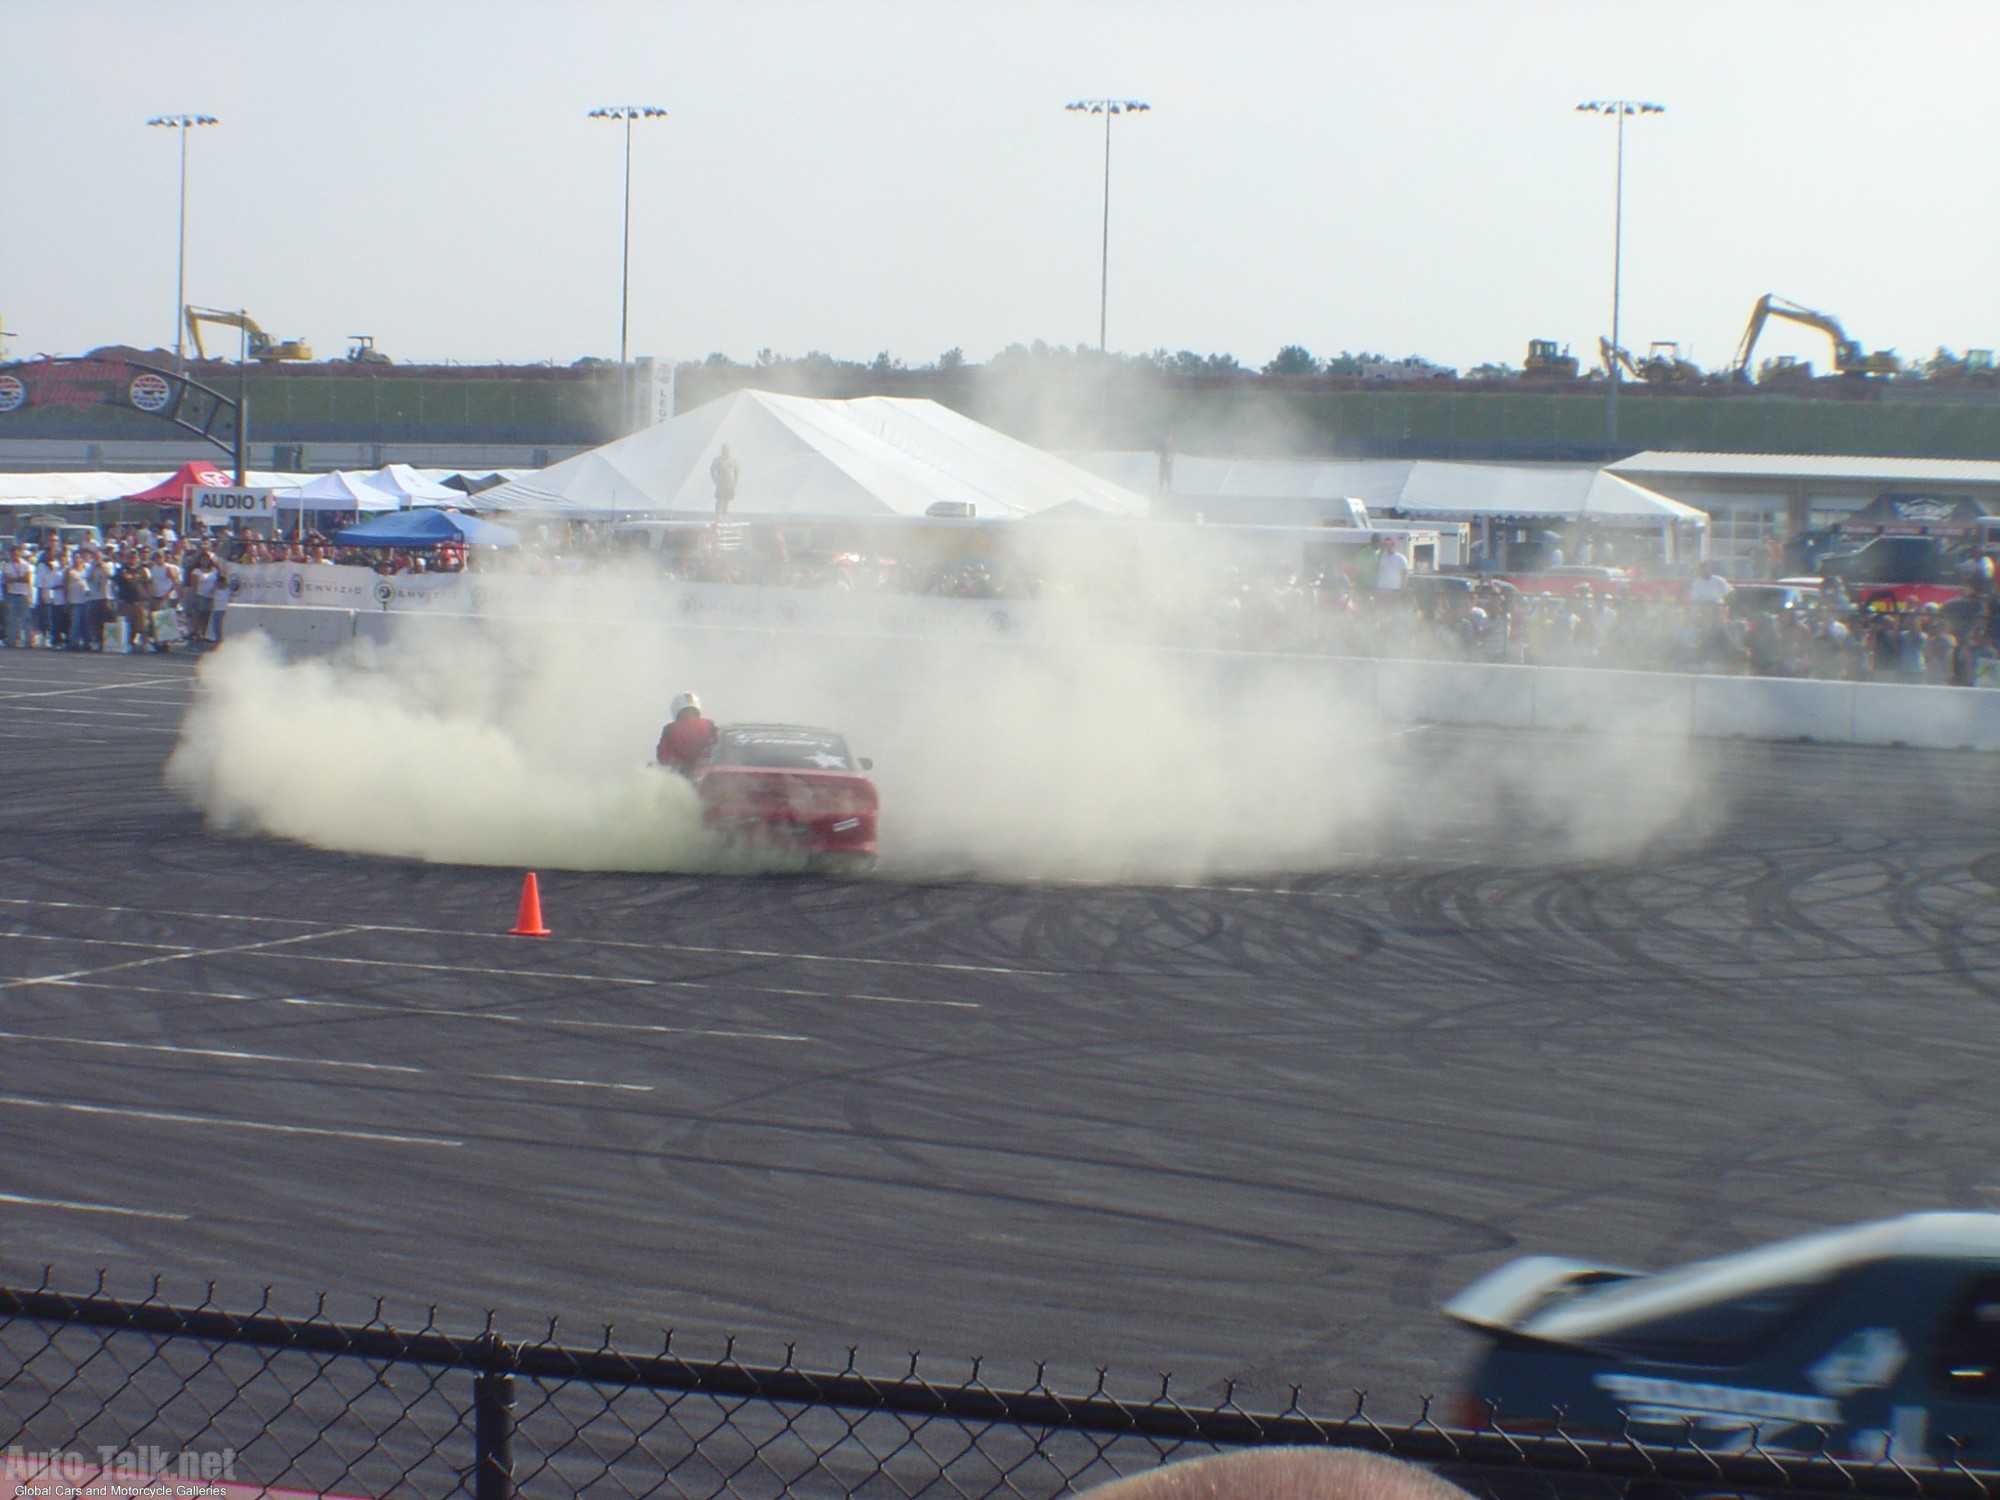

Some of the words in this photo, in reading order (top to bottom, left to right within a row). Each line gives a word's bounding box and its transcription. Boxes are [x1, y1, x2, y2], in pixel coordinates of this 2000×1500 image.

[201, 493, 255, 510] AUDIO
[259, 495, 267, 510] 1
[305, 583, 362, 595] ENVIZIO
